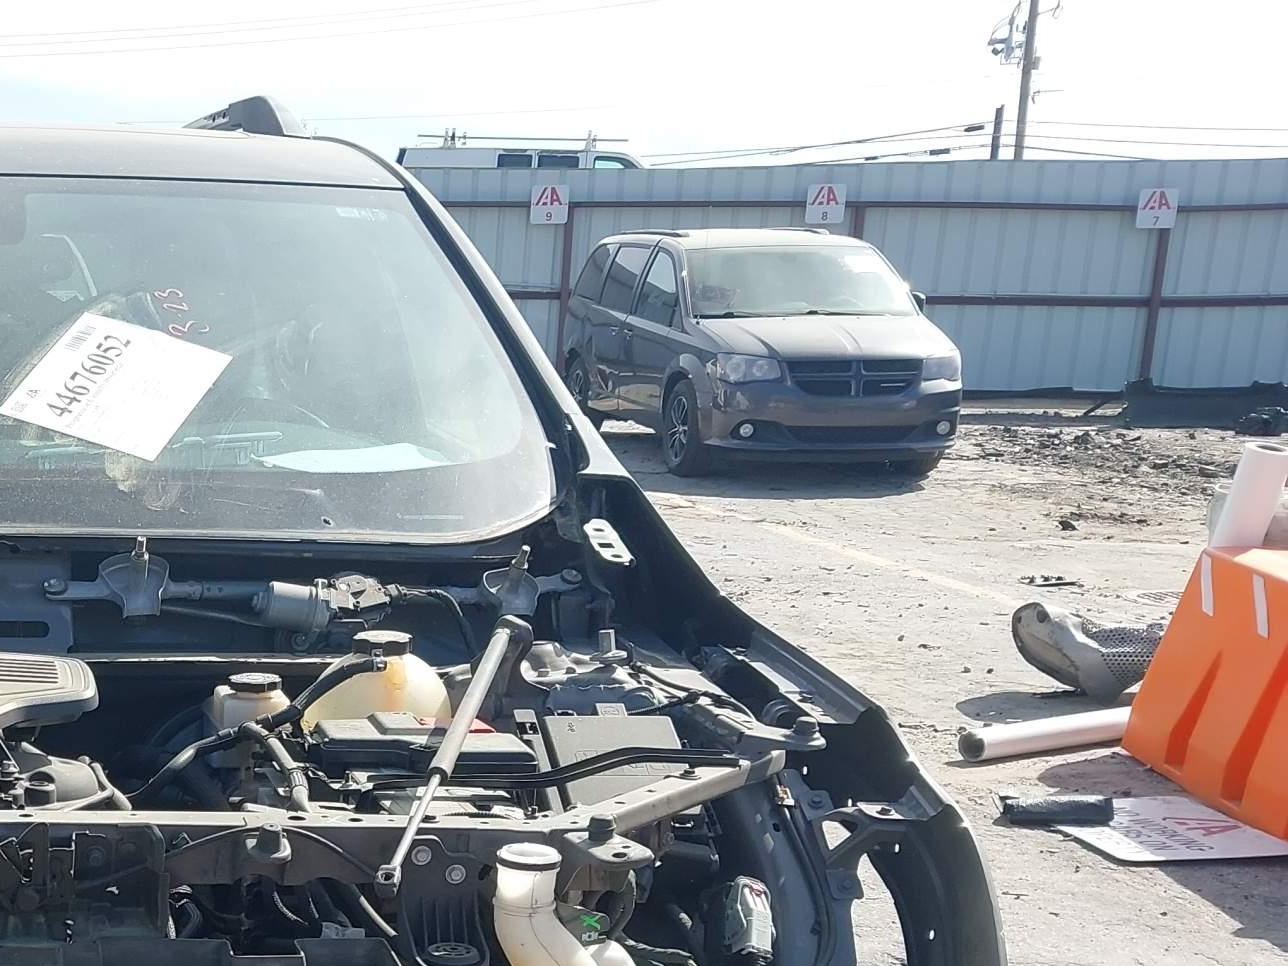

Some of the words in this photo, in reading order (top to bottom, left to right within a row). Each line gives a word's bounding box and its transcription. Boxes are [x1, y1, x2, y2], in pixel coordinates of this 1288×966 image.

[545, 211, 553, 222] 9
[821, 211, 828, 221] 8
[1152, 215, 1160, 226] 7
[46, 335, 132, 418] 44676052
[1127, 817, 1215, 852] WORKING
[1138, 839, 1181, 851] ON
